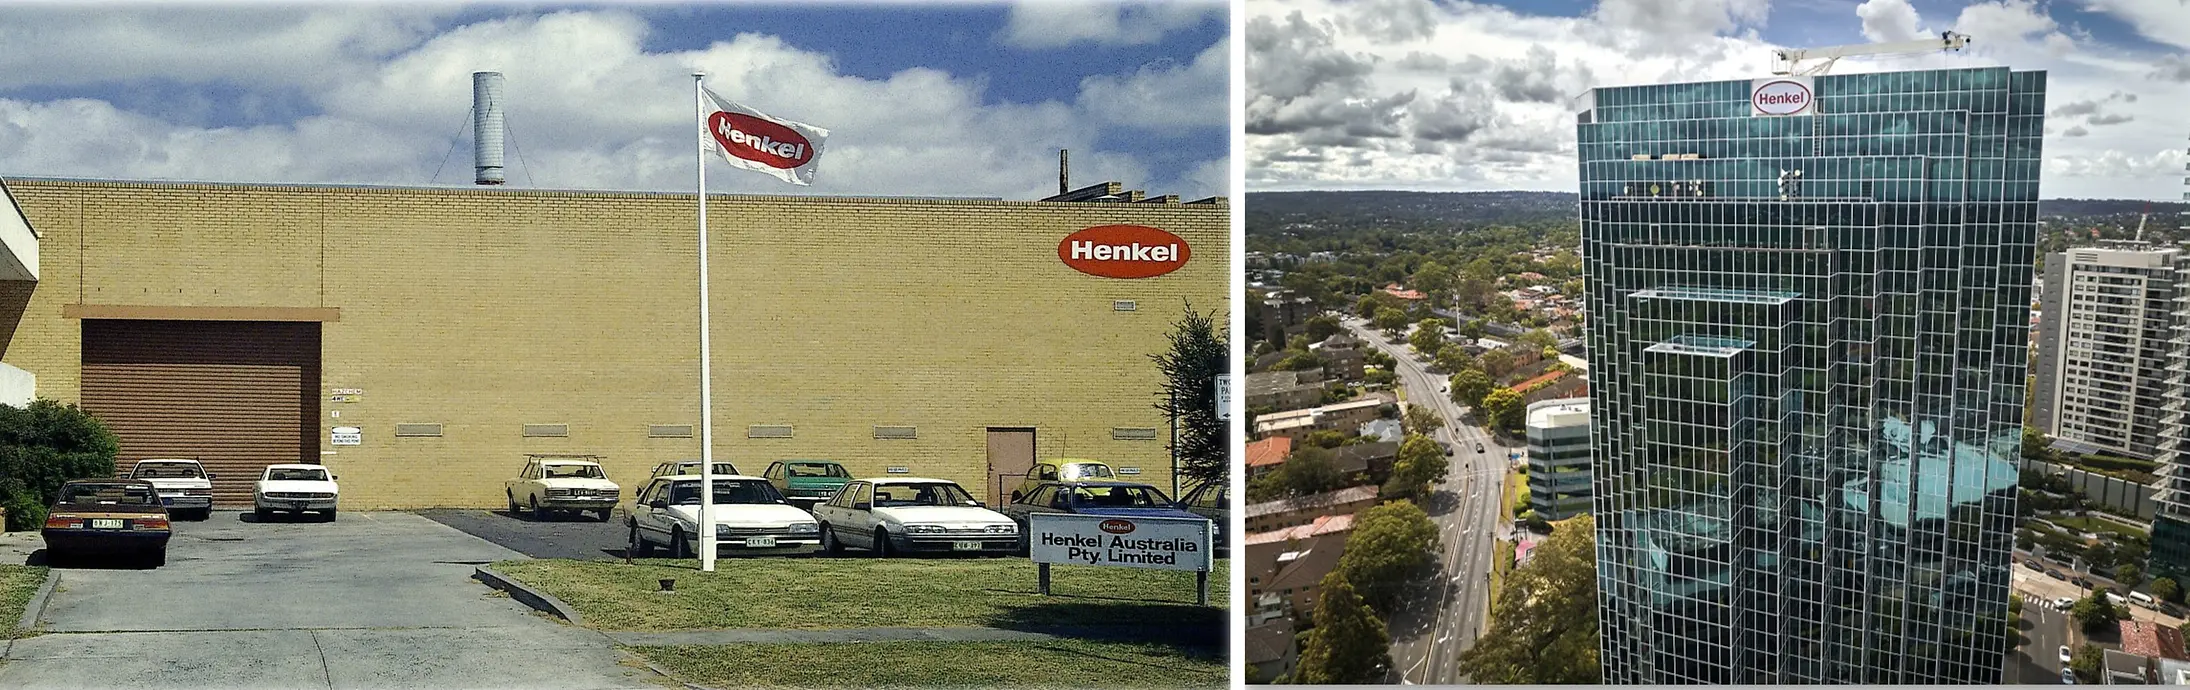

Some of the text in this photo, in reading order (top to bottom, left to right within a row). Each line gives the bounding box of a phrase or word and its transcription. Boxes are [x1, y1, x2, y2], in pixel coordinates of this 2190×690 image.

[1759, 91, 1804, 105] Henkel
[718, 116, 804, 160] Henkel
[1071, 240, 1178, 261] Henkel
[1102, 522, 1131, 531] Henkel
[1041, 532, 1198, 552] Henkel Australia
[1068, 547, 1176, 565] Pty. Limited
